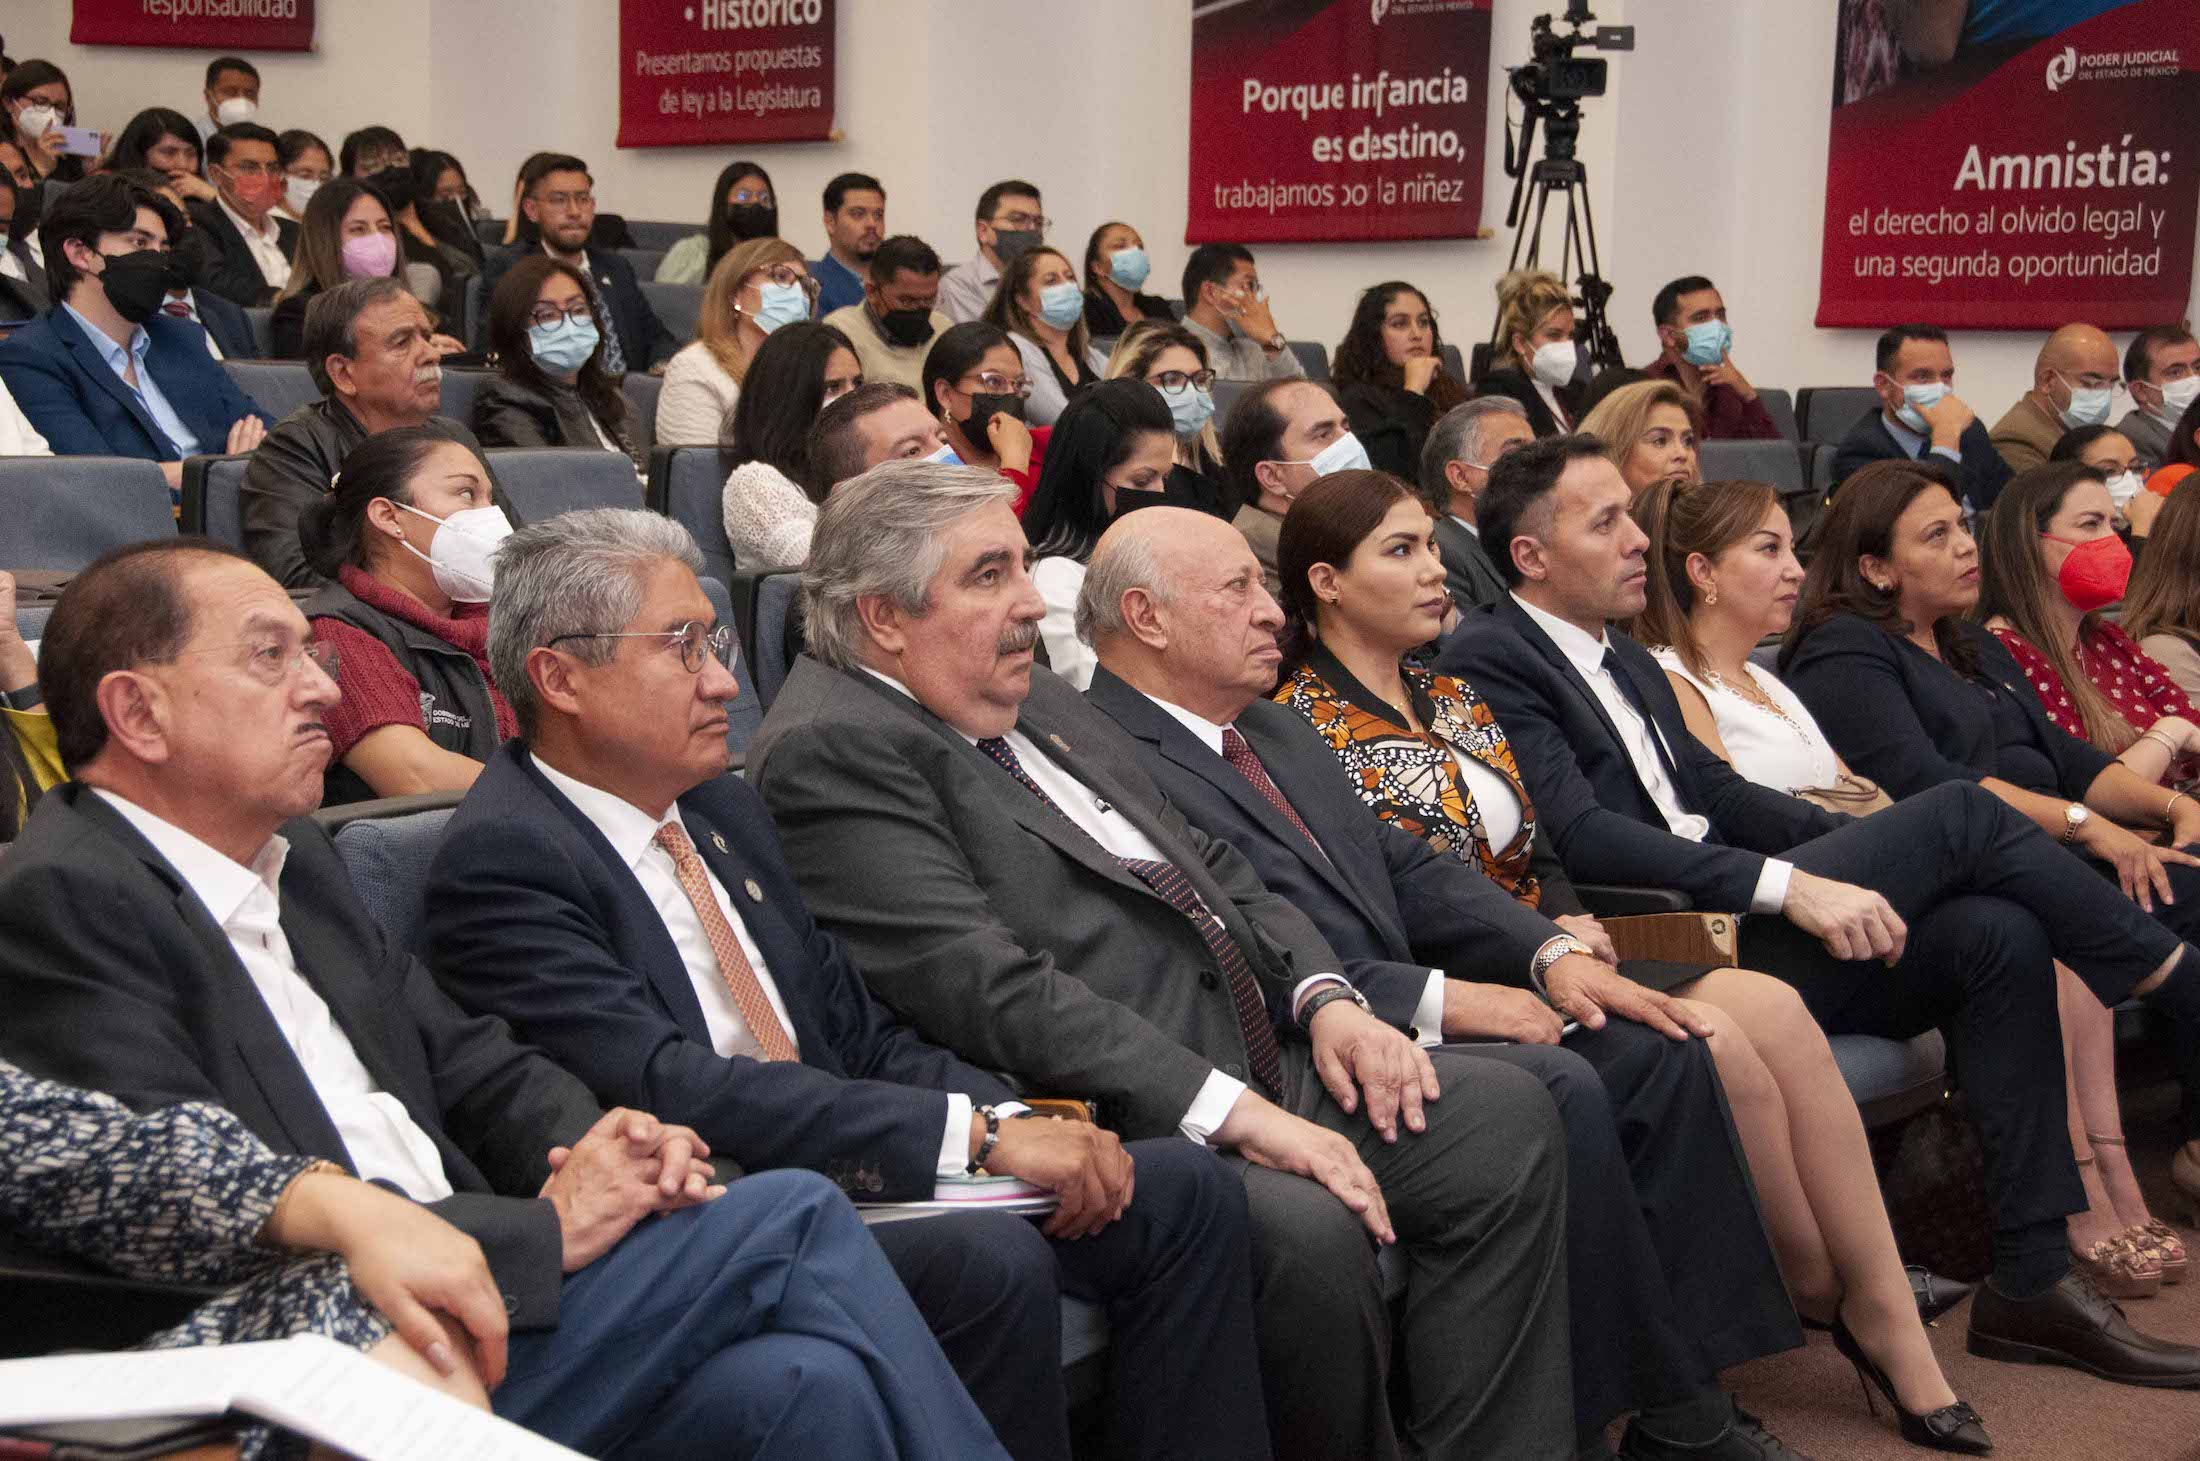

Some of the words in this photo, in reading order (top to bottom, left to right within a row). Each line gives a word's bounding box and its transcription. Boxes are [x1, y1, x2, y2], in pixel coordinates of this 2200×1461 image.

[636, 50, 731, 75] Presentamos
[735, 46, 822, 77] propuestas
[2079, 71, 2093, 80] DEL
[2095, 68, 2128, 79] ESTADO
[2130, 67, 2142, 77] DE
[2080, 53, 2120, 67] PODER
[2122, 50, 2179, 67] JUDICIAL
[659, 88, 679, 114] de
[682, 86, 704, 119] ley
[707, 92, 716, 112] a
[719, 85, 733, 111] la
[737, 82, 822, 117] Legislatura
[1243, 79, 1345, 121] Porque
[1352, 67, 1468, 118] infancia
[1312, 135, 1343, 162] es
[1348, 122, 1465, 163] destino,
[1953, 134, 2171, 191] Amnistía:
[1215, 178, 1335, 214] trabajamos
[1377, 176, 1396, 205] la
[1403, 172, 1464, 203] niñez
[1849, 208, 1868, 236] el
[1874, 207, 1969, 236] derecho
[1976, 205, 1995, 235] al
[2001, 205, 2076, 234] olvido
[2083, 202, 2142, 240] legal
[2150, 209, 2165, 239] y
[1854, 255, 1895, 277] una
[1902, 249, 2000, 285] segunda
[2008, 247, 2160, 285] oportunidad
